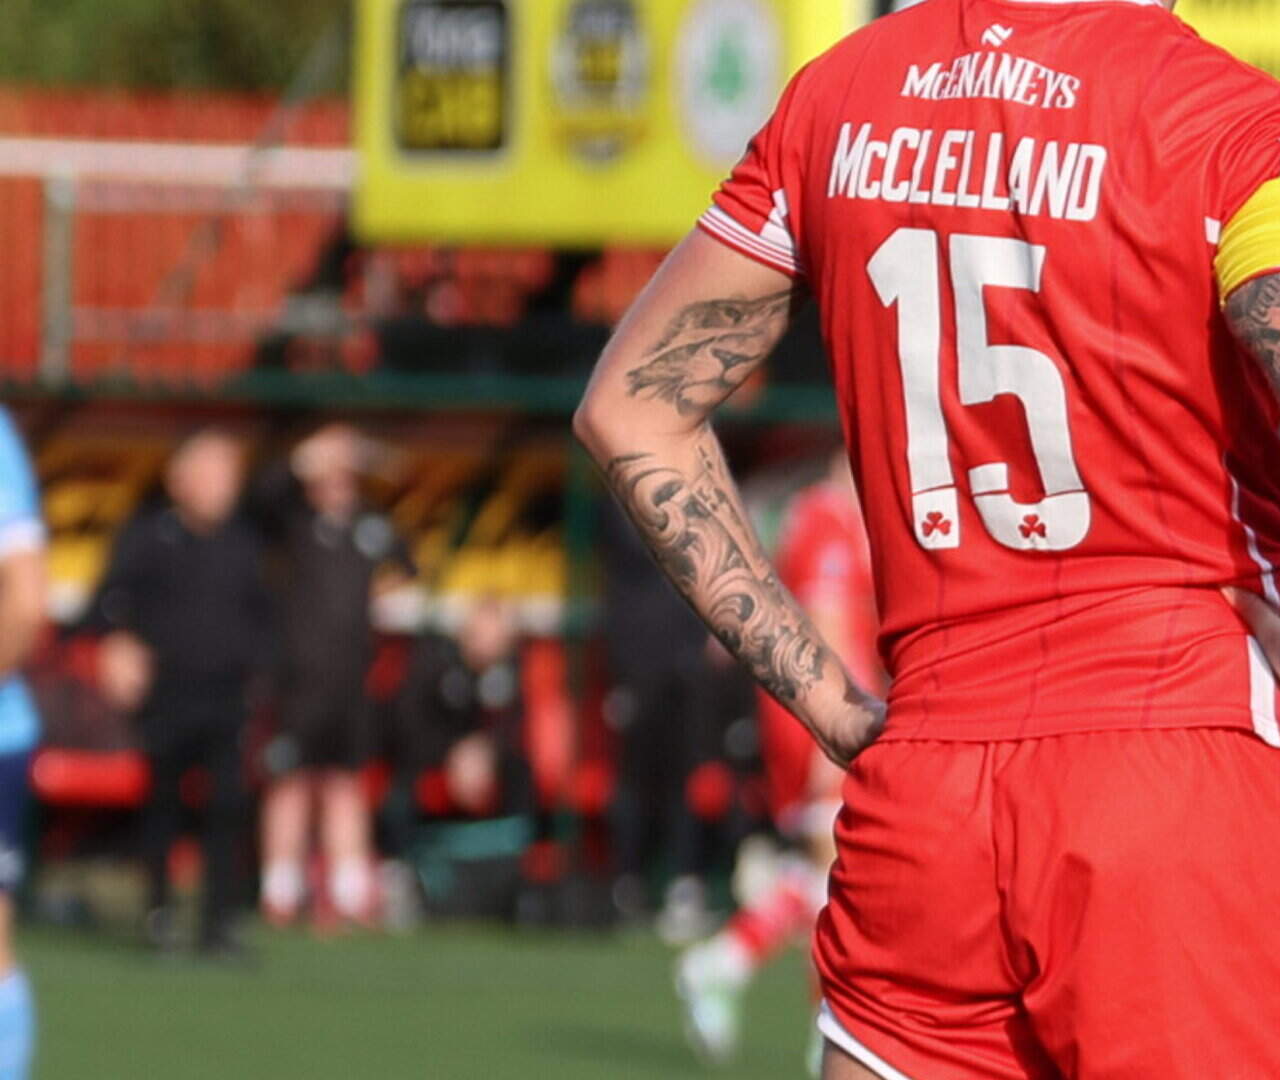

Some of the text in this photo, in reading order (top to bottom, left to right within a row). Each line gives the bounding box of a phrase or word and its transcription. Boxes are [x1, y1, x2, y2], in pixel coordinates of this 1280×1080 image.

[901, 52, 1081, 109] McENANEYS
[828, 122, 1106, 222] McCLELLAND
[867, 228, 1091, 552] 15
